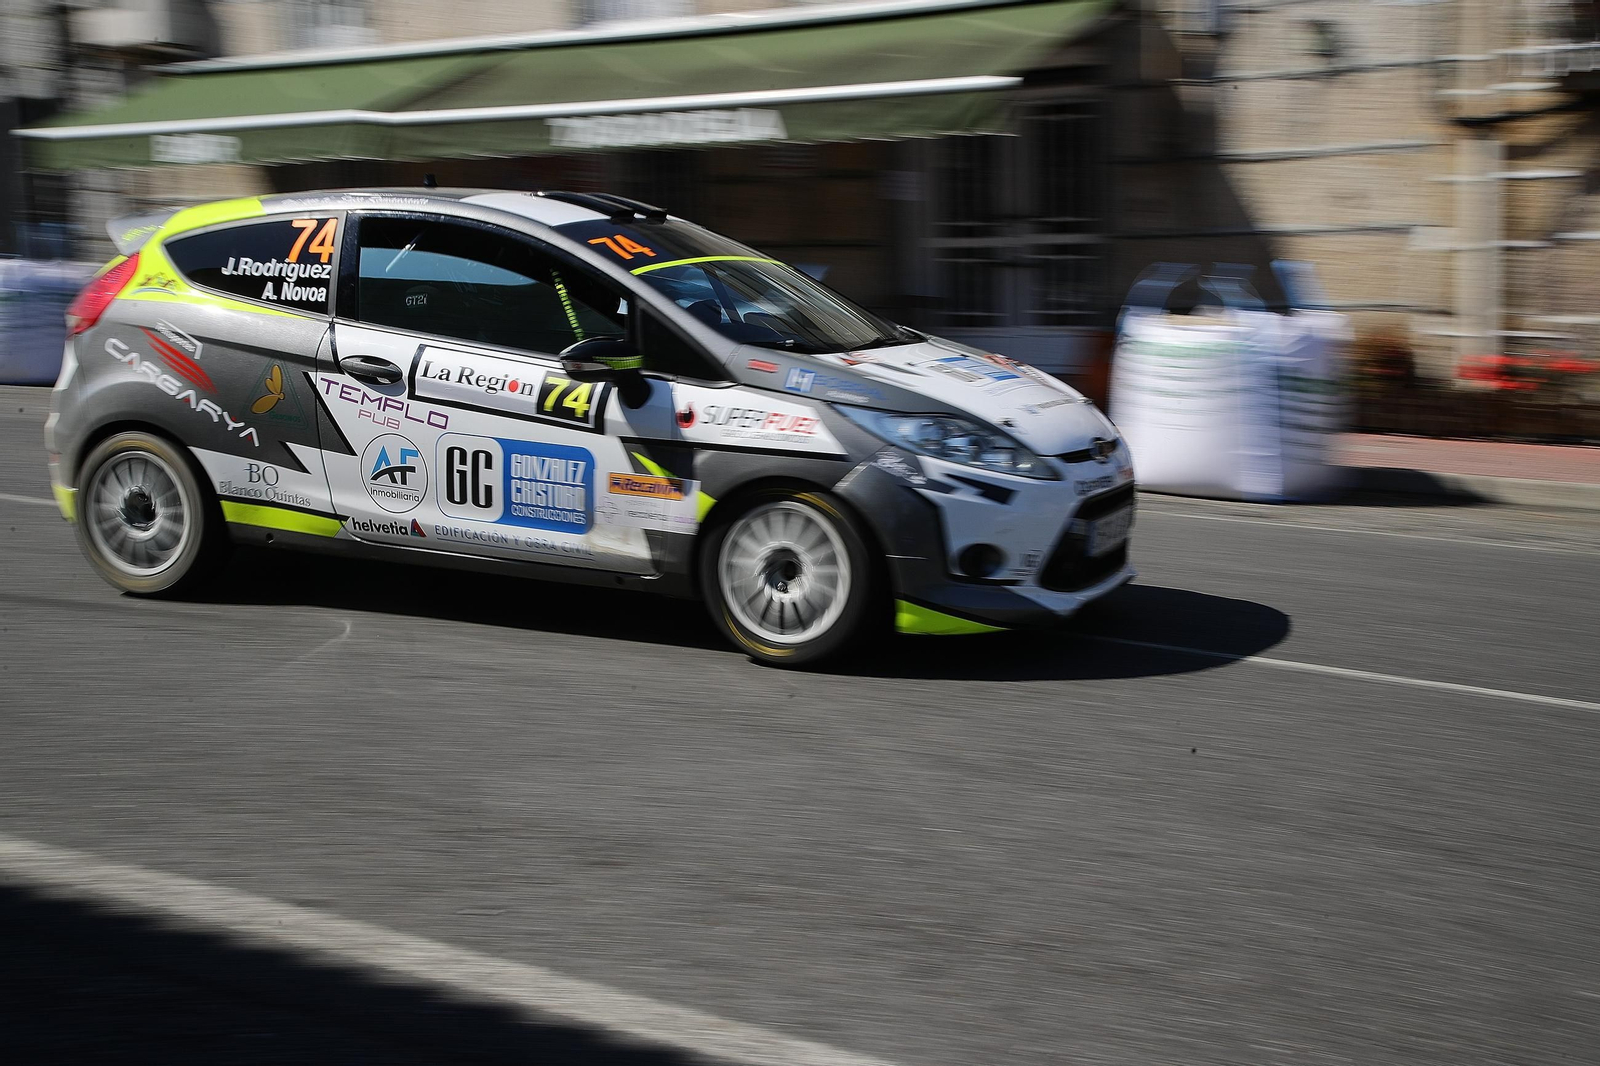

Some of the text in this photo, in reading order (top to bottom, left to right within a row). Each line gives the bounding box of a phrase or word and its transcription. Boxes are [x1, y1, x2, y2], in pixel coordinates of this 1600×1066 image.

[288, 218, 338, 263] 74
[587, 234, 657, 259] 74
[261, 281, 327, 302] A. Novoa
[420, 359, 452, 382] La
[320, 377, 449, 430] TEMPLO
[543, 376, 595, 418] 74
[358, 409, 401, 430] PUB
[370, 445, 419, 486] AF
[446, 446, 493, 509] GC
[219, 480, 312, 508] Blanco Quintas
[351, 517, 409, 536] helvetia
[434, 524, 509, 545] EDIFICACIÓN
[512, 535, 521, 547] Y
